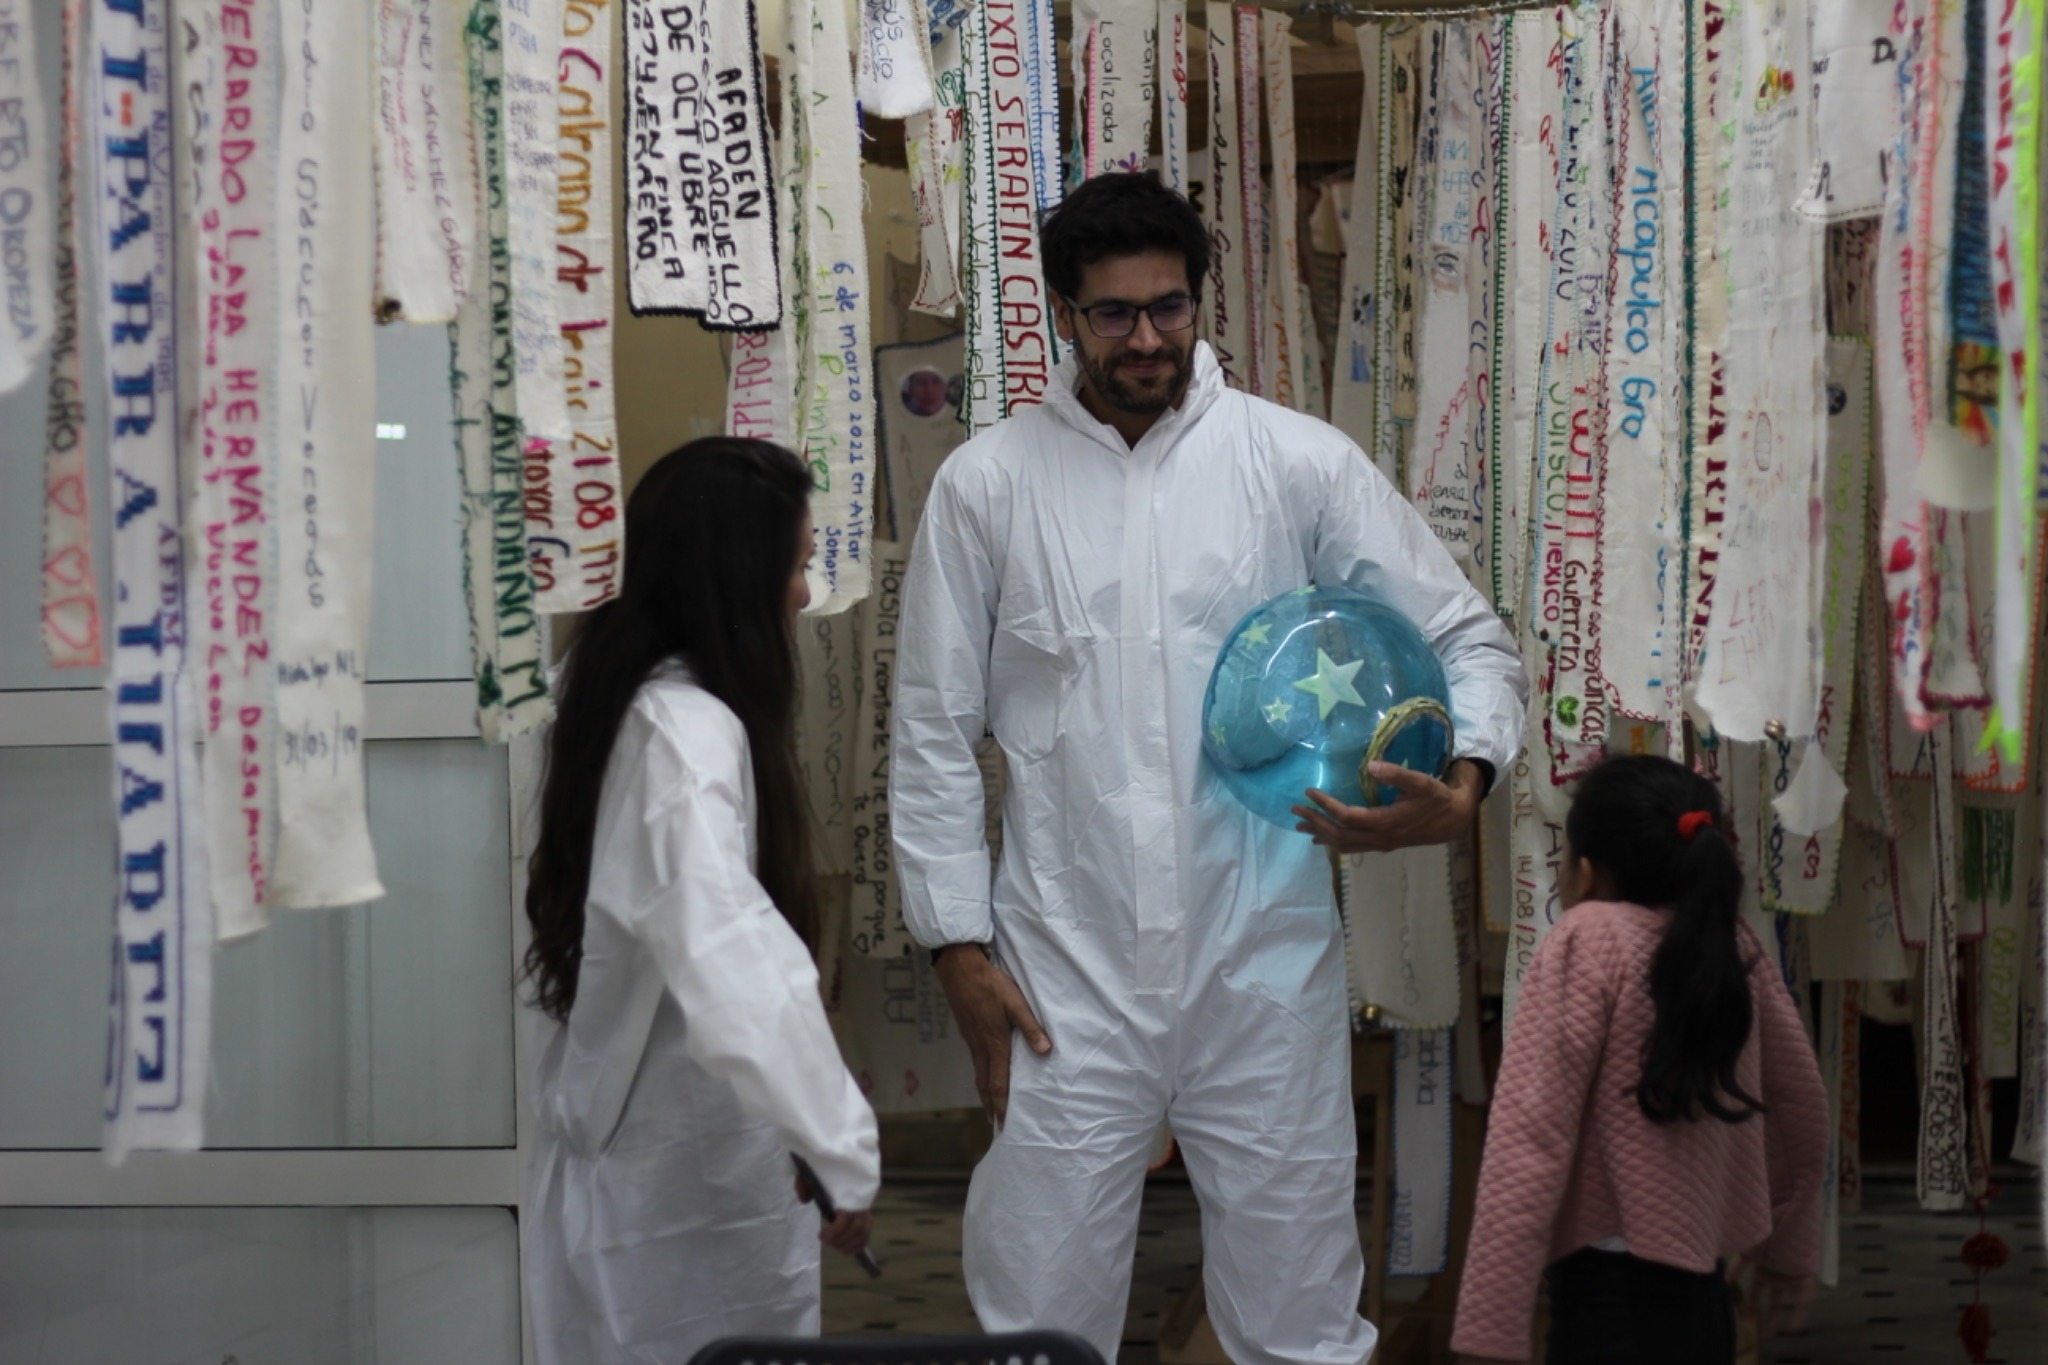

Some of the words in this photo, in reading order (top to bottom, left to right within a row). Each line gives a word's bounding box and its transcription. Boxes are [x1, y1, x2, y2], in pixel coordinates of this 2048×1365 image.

[660, 6, 695, 53] DE
[1099, 20, 1122, 144] Localizada
[671, 72, 710, 252] OCTUBRE
[714, 66, 762, 221] AFADEN
[993, 89, 1036, 262] SERAFIN
[655, 175, 686, 279] FINCA
[706, 158, 755, 326] ARGUELLO
[832, 262, 855, 278] 6
[1620, 165, 1661, 356] Acapulco
[835, 286, 860, 313] de
[840, 324, 862, 402] marzo
[1621, 376, 1658, 439] Gro
[849, 411, 865, 464] 2021
[846, 500, 866, 564] Altar
[1558, 560, 1589, 673] Guerrero
[500, 659, 549, 709] M
